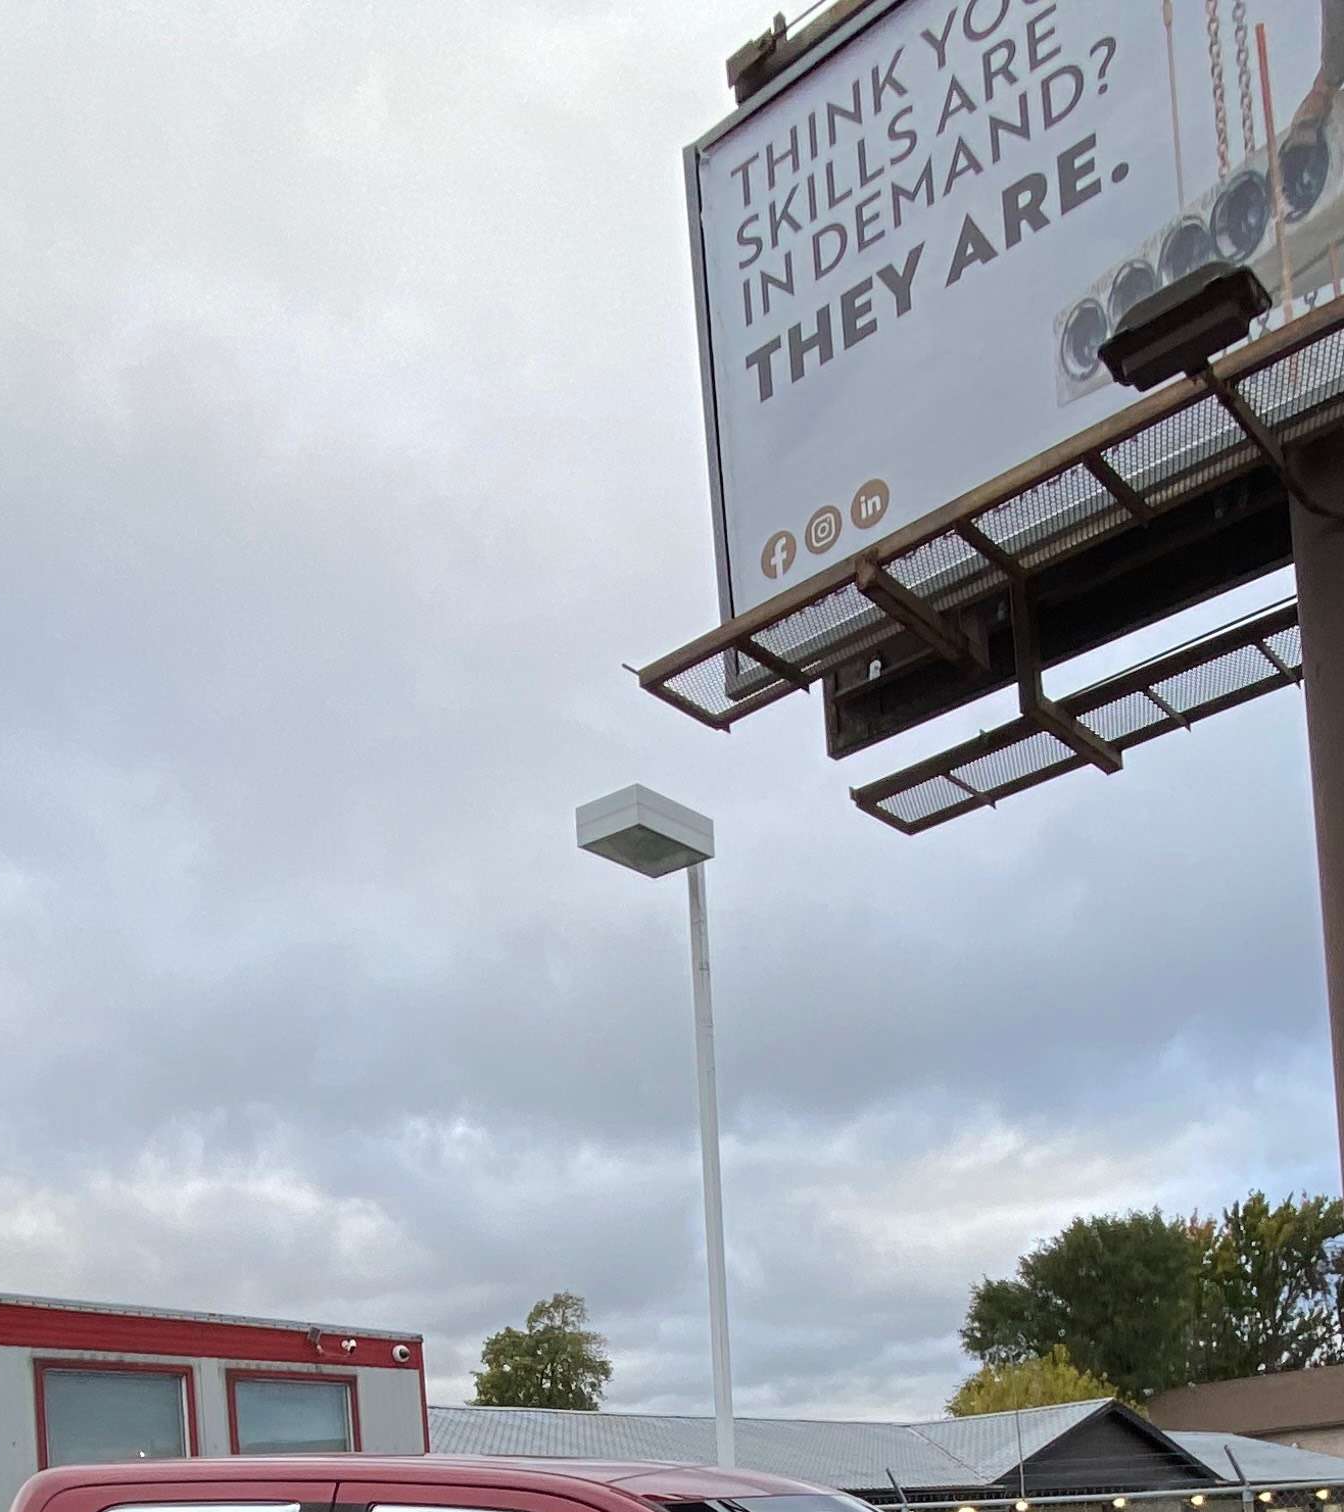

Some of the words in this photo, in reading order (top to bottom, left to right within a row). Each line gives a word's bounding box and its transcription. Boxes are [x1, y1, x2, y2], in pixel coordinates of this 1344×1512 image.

[730, 45, 908, 207] THINK
[921, 0, 1041, 70] YO
[736, 105, 917, 270] SKILLS
[936, 4, 1062, 137] ARE
[742, 268, 794, 327] IN
[812, 36, 1117, 281] DEMAND?
[745, 242, 925, 402] THEY
[944, 133, 1130, 288] ARE.
